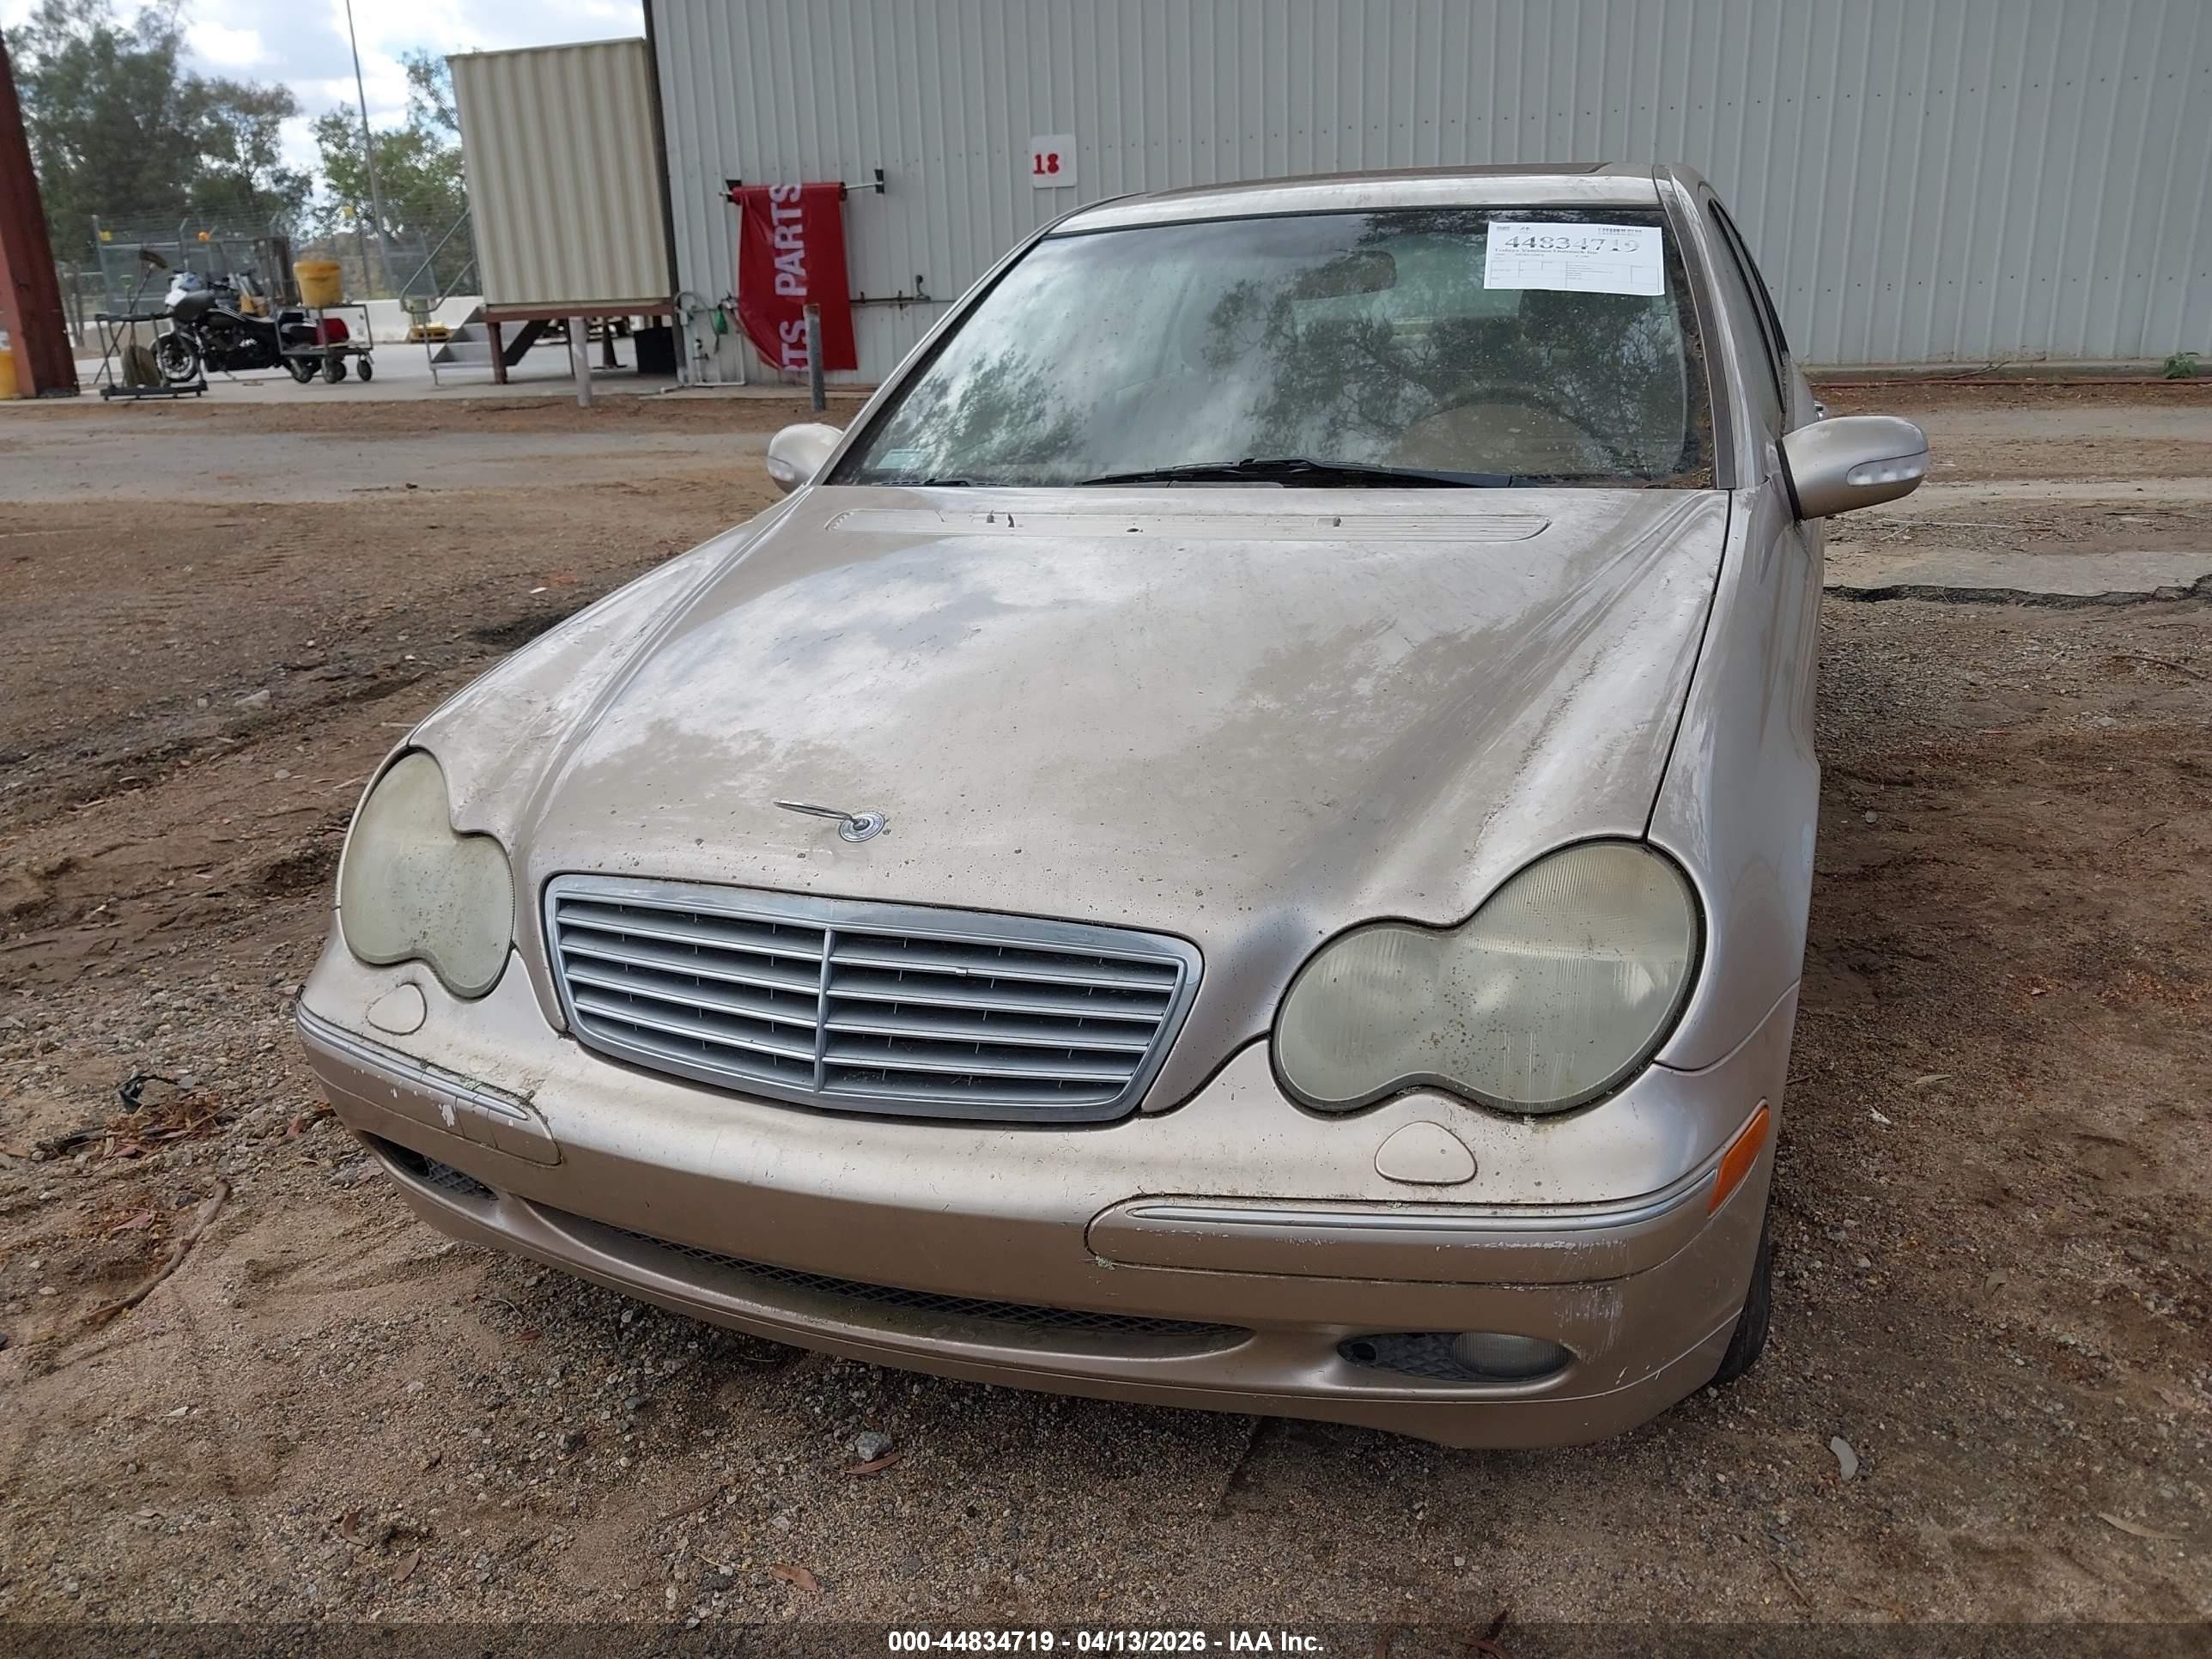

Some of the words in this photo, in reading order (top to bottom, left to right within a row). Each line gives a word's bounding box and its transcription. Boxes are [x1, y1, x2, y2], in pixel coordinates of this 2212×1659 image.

[1033, 153, 1060, 174] 18
[769, 183, 808, 296] PARTS
[1504, 235, 1640, 253] 44834719
